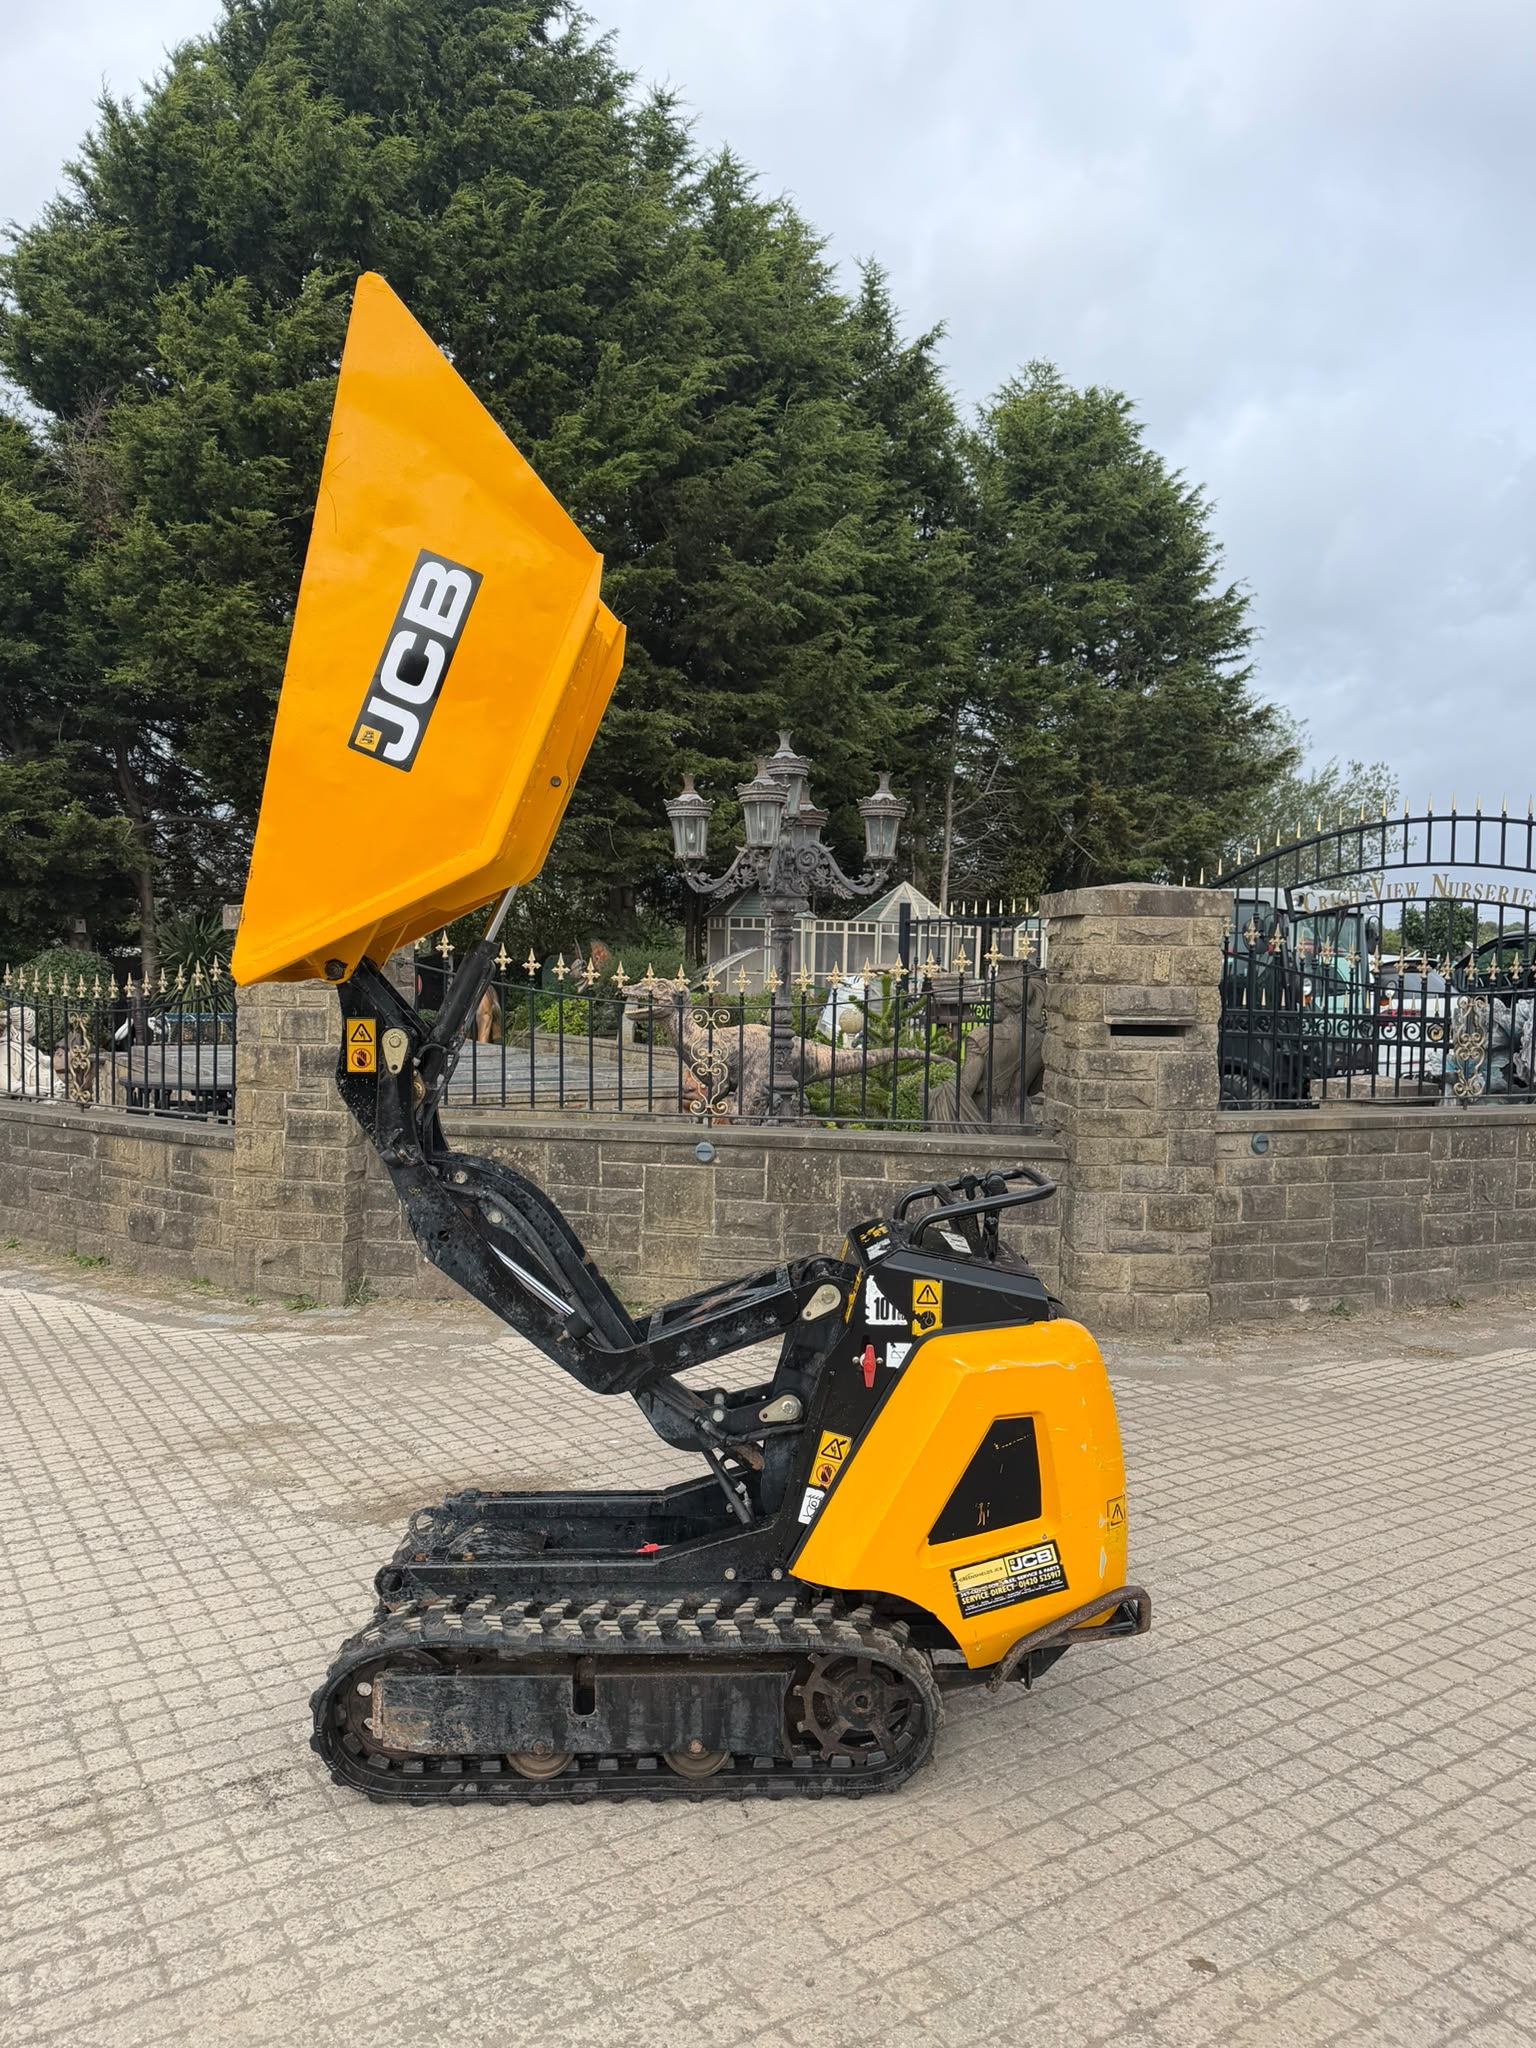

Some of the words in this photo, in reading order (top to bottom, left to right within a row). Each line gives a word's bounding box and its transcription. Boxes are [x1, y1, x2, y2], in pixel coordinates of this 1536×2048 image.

[367, 561, 472, 762] JCB
[1368, 877, 1419, 901] VIEW
[1431, 873, 1536, 908] NURSERIE
[1010, 1549, 1052, 1571] JCB
[961, 1591, 990, 1606] SERVICE
